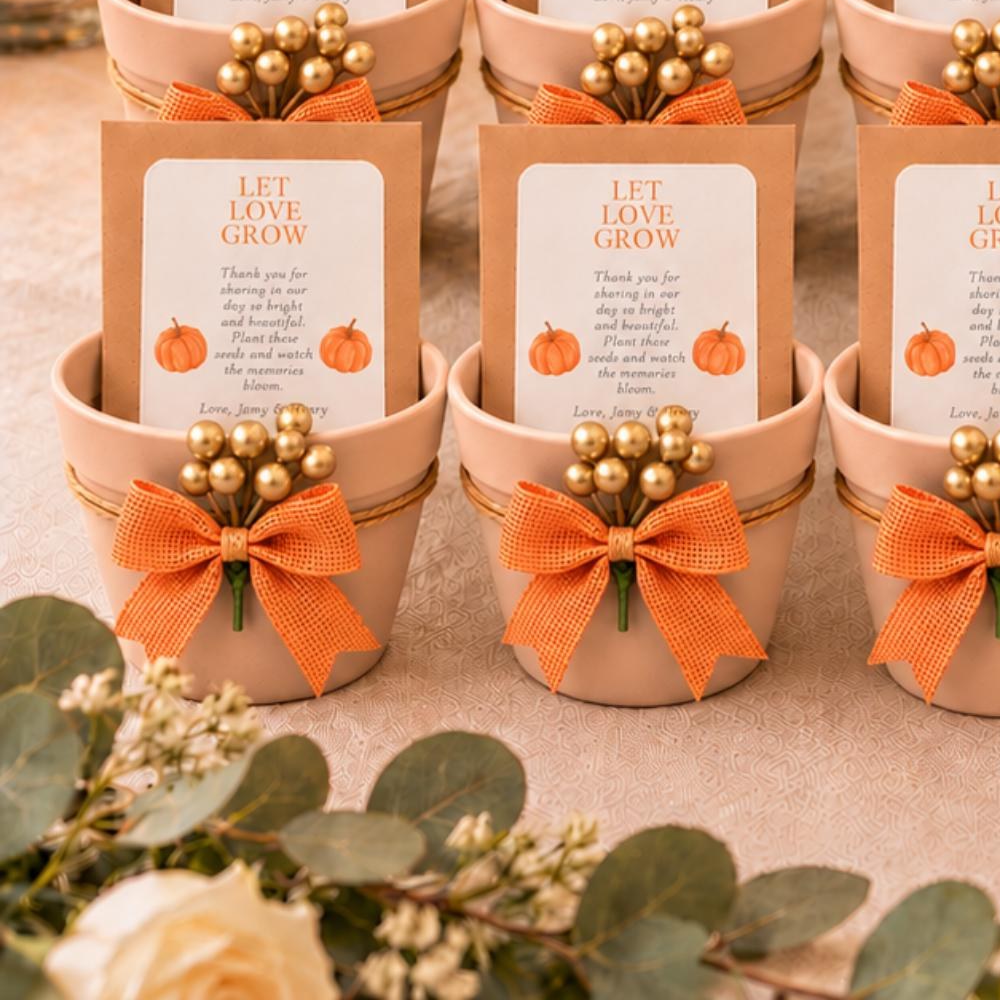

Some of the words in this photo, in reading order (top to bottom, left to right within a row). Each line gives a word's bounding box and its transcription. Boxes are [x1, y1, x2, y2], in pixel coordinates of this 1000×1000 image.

[239, 175, 290, 197] LET
[612, 179, 663, 201] LET
[230, 199, 302, 220] LOVE
[602, 204, 675, 225] LOVE
[220, 223, 308, 244] GROW
[593, 228, 681, 249] GROW
[222, 267, 260, 279] Thank
[264, 270, 286, 282] you
[289, 267, 308, 282] for
[594, 270, 632, 283] Thank
[636, 274, 658, 286] you
[660, 270, 680, 286] for
[214, 347, 245, 359] seeds
[250, 347, 274, 359] and
[278, 347, 313, 359] watch
[588, 350, 618, 362] seeds
[622, 350, 647, 362] and
[650, 350, 686, 362] watch
[224, 363, 243, 375] the
[248, 364, 304, 375] memories
[598, 366, 616, 378] the
[620, 367, 676, 378] memories
[647, 405, 659, 418] &
